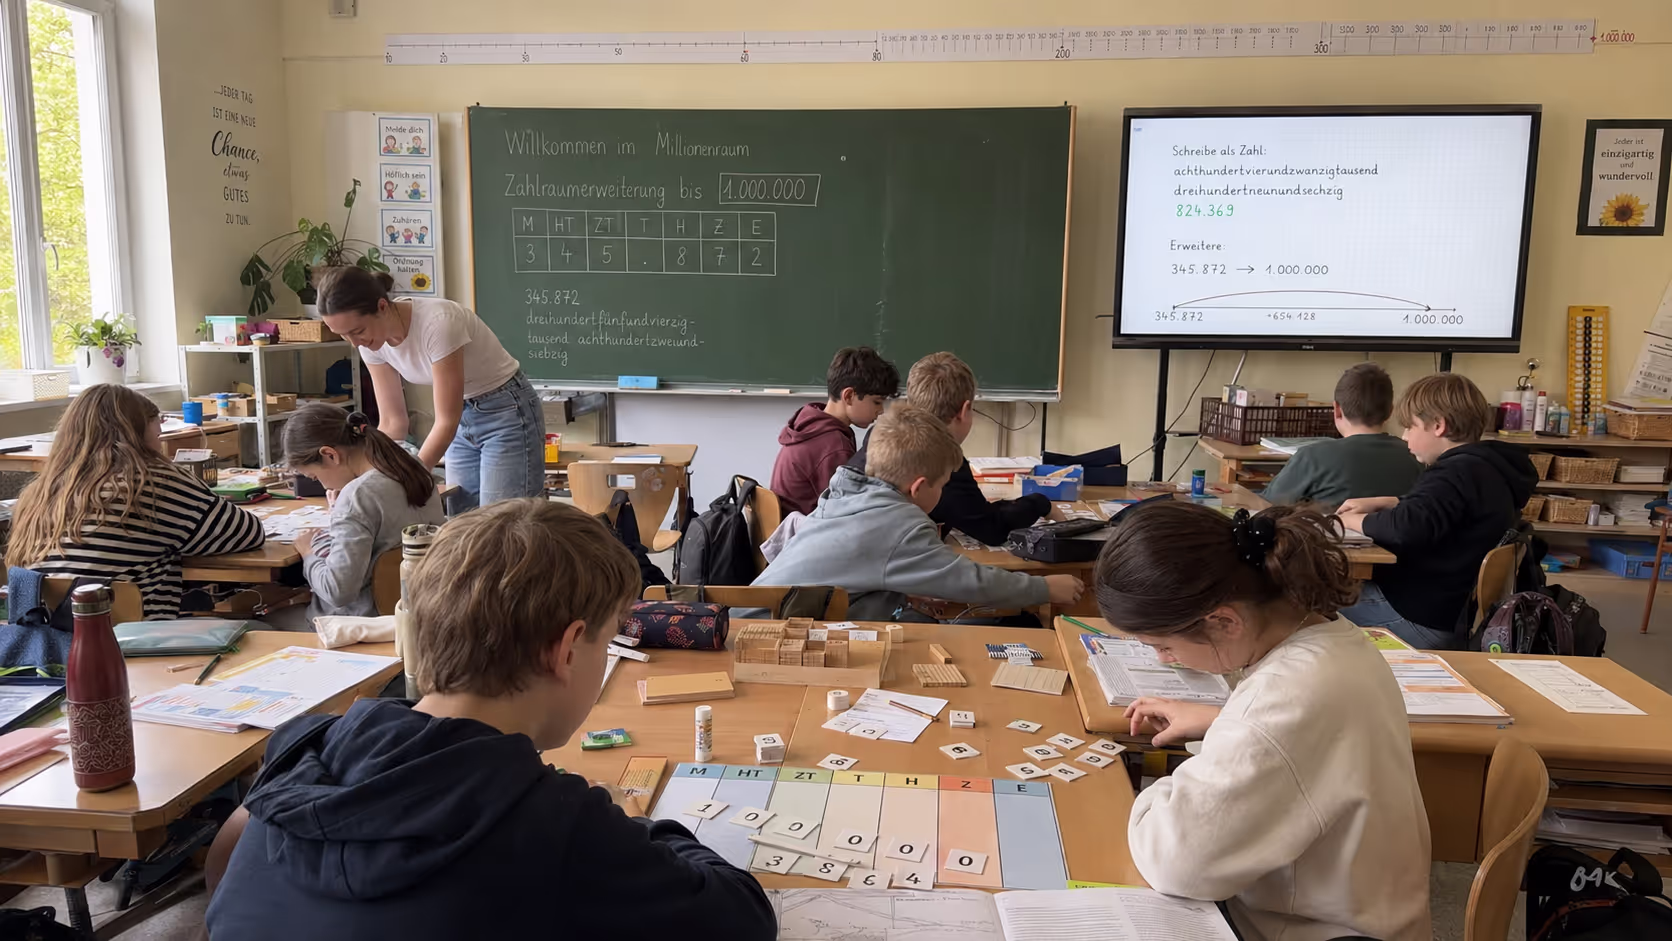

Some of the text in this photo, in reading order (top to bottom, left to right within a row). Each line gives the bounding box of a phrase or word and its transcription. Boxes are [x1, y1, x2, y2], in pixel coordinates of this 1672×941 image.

[614, 47, 623, 56] 50
[1055, 48, 1071, 59] 200
[1313, 43, 1329, 54] 300
[240, 90, 254, 105] TAG
[212, 106, 257, 129] IST EINE NEUE
[385, 125, 424, 134] Melde dich
[504, 128, 750, 157] Willkommen im Millionenraum
[1172, 144, 1267, 157] Schreibe als Zahl:
[1635, 138, 1644, 146] ist
[1600, 149, 1656, 161] einzigartig
[1173, 163, 1379, 181] achthundertvierundzwanzigtausend
[1619, 161, 1635, 169] und
[384, 170, 427, 180] Höflich sein
[1598, 171, 1654, 182] wundervoll
[223, 185, 250, 204] GUTES
[504, 173, 806, 209] Zahlraumerweiterung bis 1.000.000
[1173, 183, 1343, 201] dreihundertneunundsechzig
[225, 212, 234, 225] ZU
[1176, 203, 1234, 217] 824.369
[522, 215, 762, 235] M HT ZT T H Z E
[1170, 239, 1227, 251] Erweitere:
[525, 243, 536, 264] 3
[560, 242, 573, 264] 4
[602, 245, 613, 264] 5
[676, 246, 687, 266] 8
[714, 246, 727, 266] 7
[751, 246, 762, 267] 2
[1171, 263, 1329, 275] 345.872 1.000.000
[524, 288, 580, 306] 345.872
[526, 308, 697, 335] dreihundertfünfundvierzig-
[1154, 308, 1203, 322] 345.872
[1402, 313, 1464, 325] 1.000.000
[527, 329, 705, 348] tausend achthundertzweiund-
[528, 345, 569, 367] siebzig
[689, 767, 1028, 793] M HT ZT T H Z E
[697, 803, 974, 867] 1 0 0 0 0 0
[765, 855, 784, 867] 3
[818, 862, 835, 874] 8
[905, 872, 921, 885] 4
